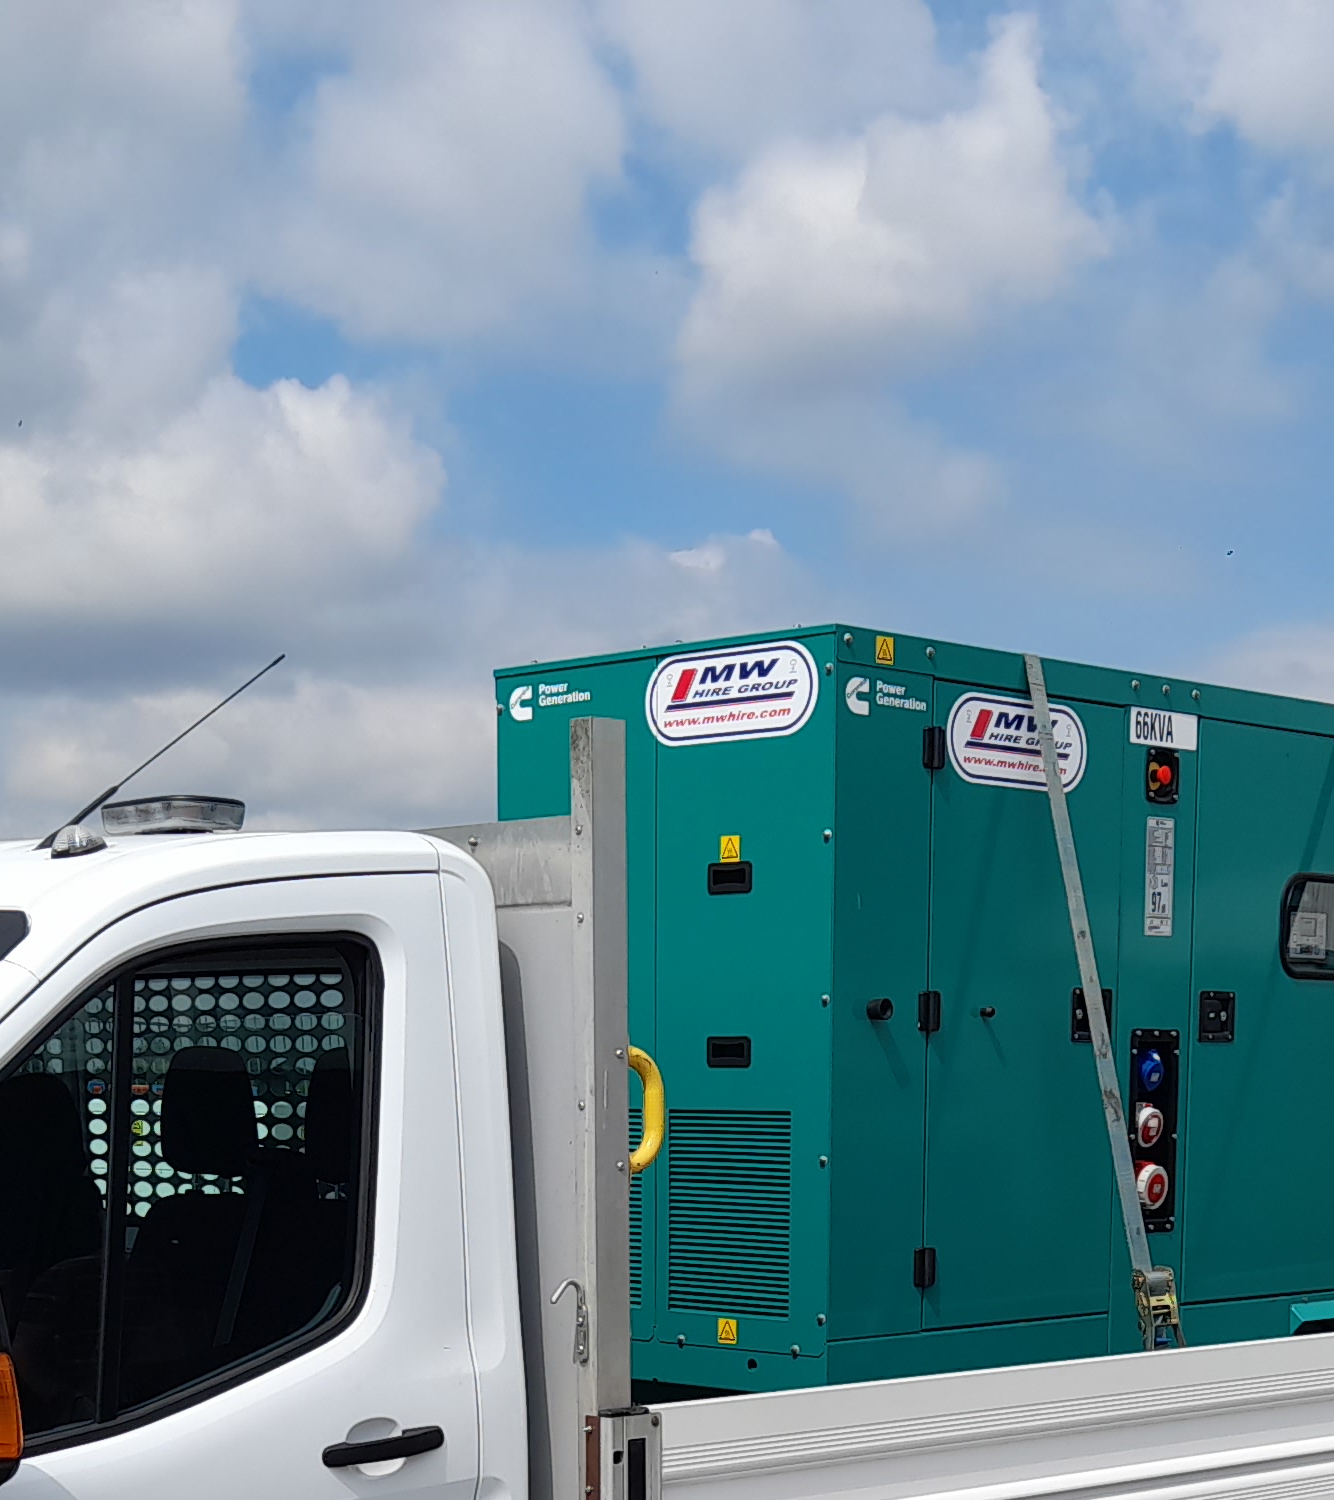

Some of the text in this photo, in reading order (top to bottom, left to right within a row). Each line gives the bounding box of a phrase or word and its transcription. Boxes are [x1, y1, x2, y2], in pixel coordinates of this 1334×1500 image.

[699, 658, 780, 686] MW
[538, 683, 568, 695] Power
[692, 679, 798, 700] HIRE GROUP
[876, 680, 906, 695] Power
[538, 691, 591, 707] Generation
[875, 692, 927, 711] Generation
[663, 707, 792, 729] www.mwhire.com
[1135, 710, 1174, 743] 66KVA
[988, 732, 1073, 750] HIRE GUP
[963, 755, 1068, 776] www.mwhire.m
[1151, 891, 1162, 913] 97
